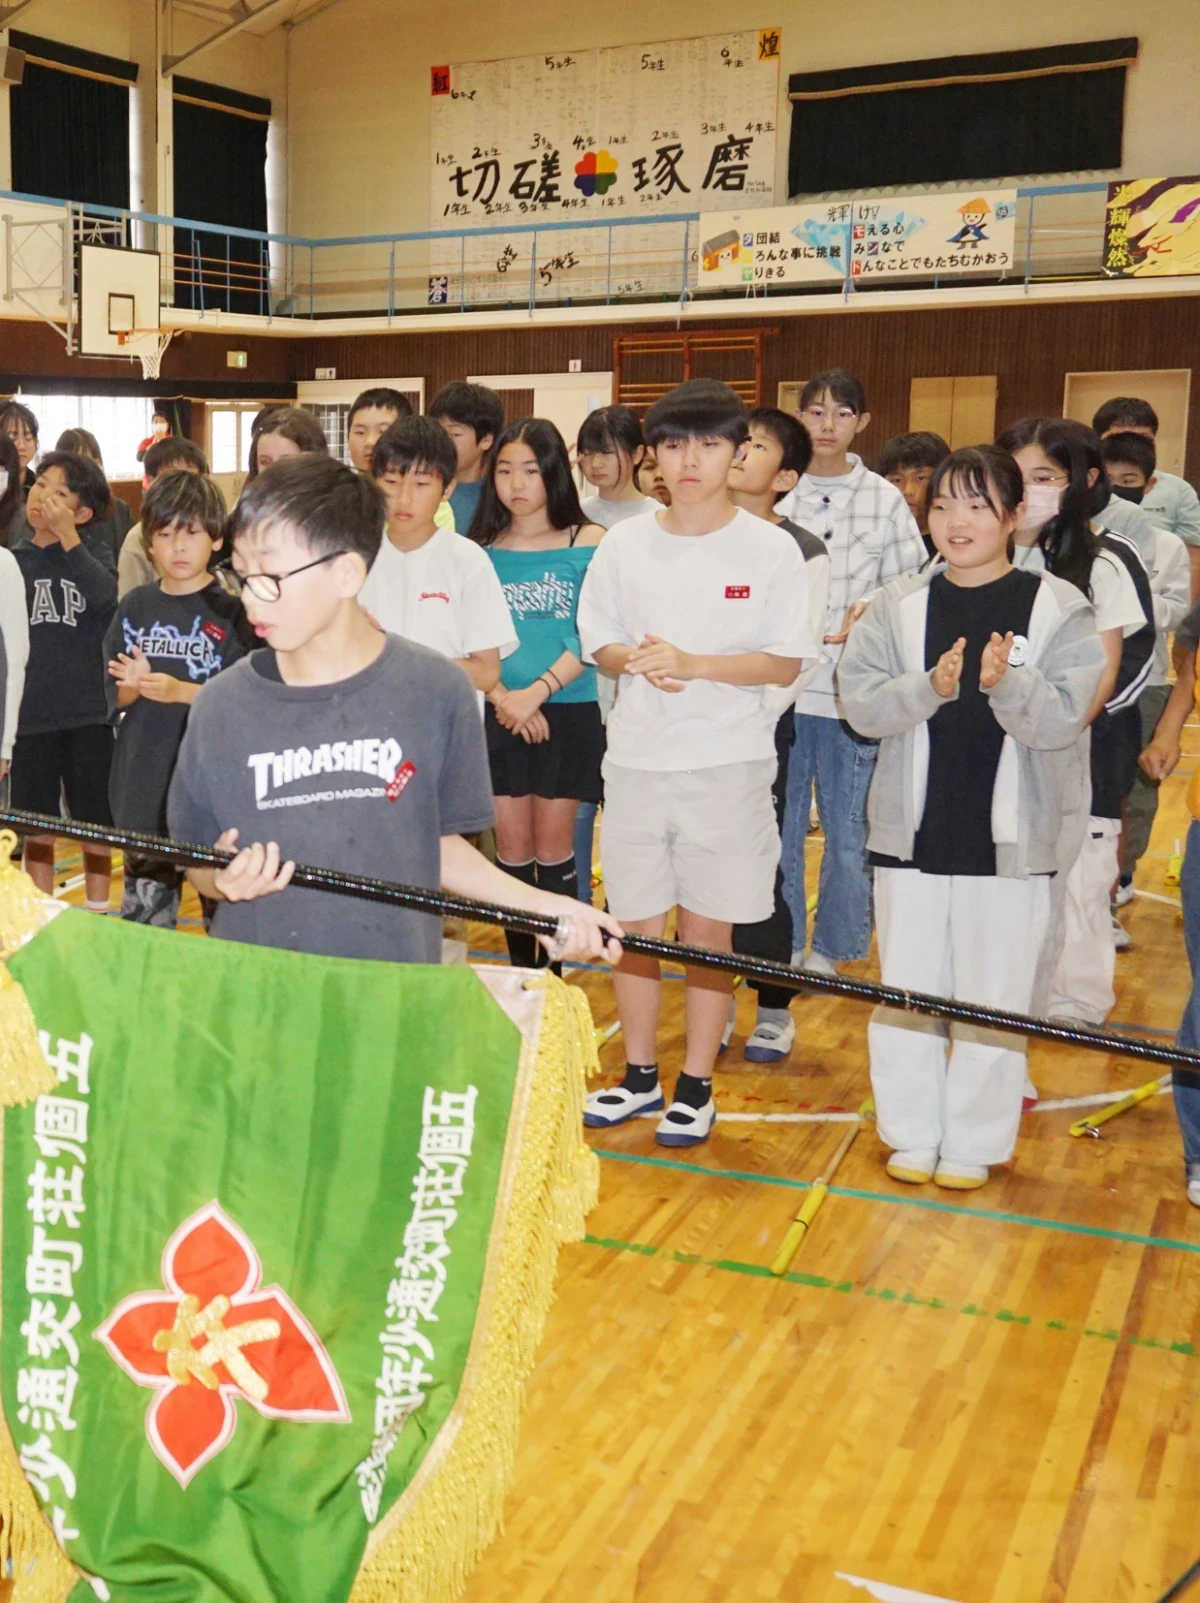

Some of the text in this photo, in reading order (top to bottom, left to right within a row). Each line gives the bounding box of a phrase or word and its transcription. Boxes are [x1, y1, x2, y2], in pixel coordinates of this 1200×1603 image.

[742, 246, 841, 264] ろんな事に挑戦
[30, 578, 86, 627] AP
[138, 632, 215, 663] ETALLICA
[247, 737, 402, 802] THRASHER
[256, 790, 335, 811] SKATEBOARD
